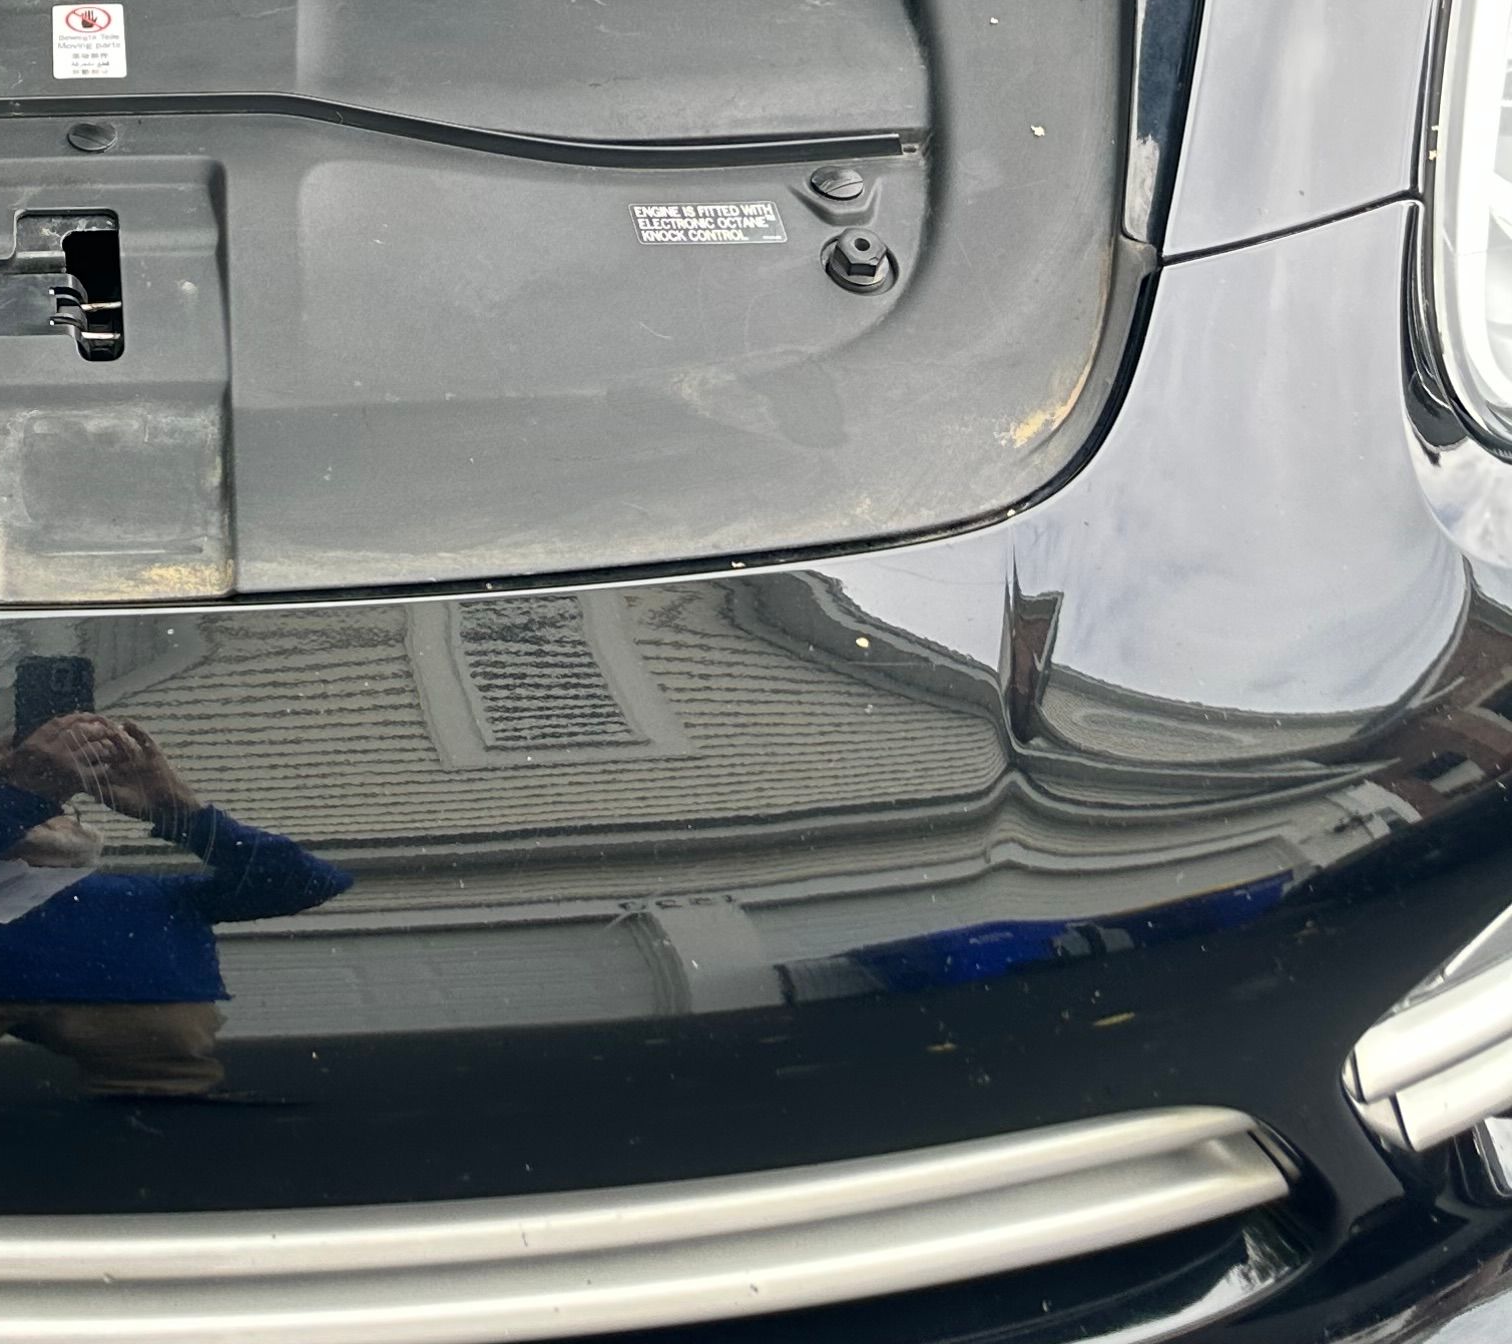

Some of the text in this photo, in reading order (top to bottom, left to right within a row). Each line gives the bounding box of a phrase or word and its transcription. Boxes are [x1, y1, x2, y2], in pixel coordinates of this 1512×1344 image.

[633, 203, 773, 218] ENGINE IS FITTED WITH
[638, 218, 716, 230] ELECTRONIC
[717, 217, 769, 229] OCTANE
[641, 230, 688, 242] KNOCK
